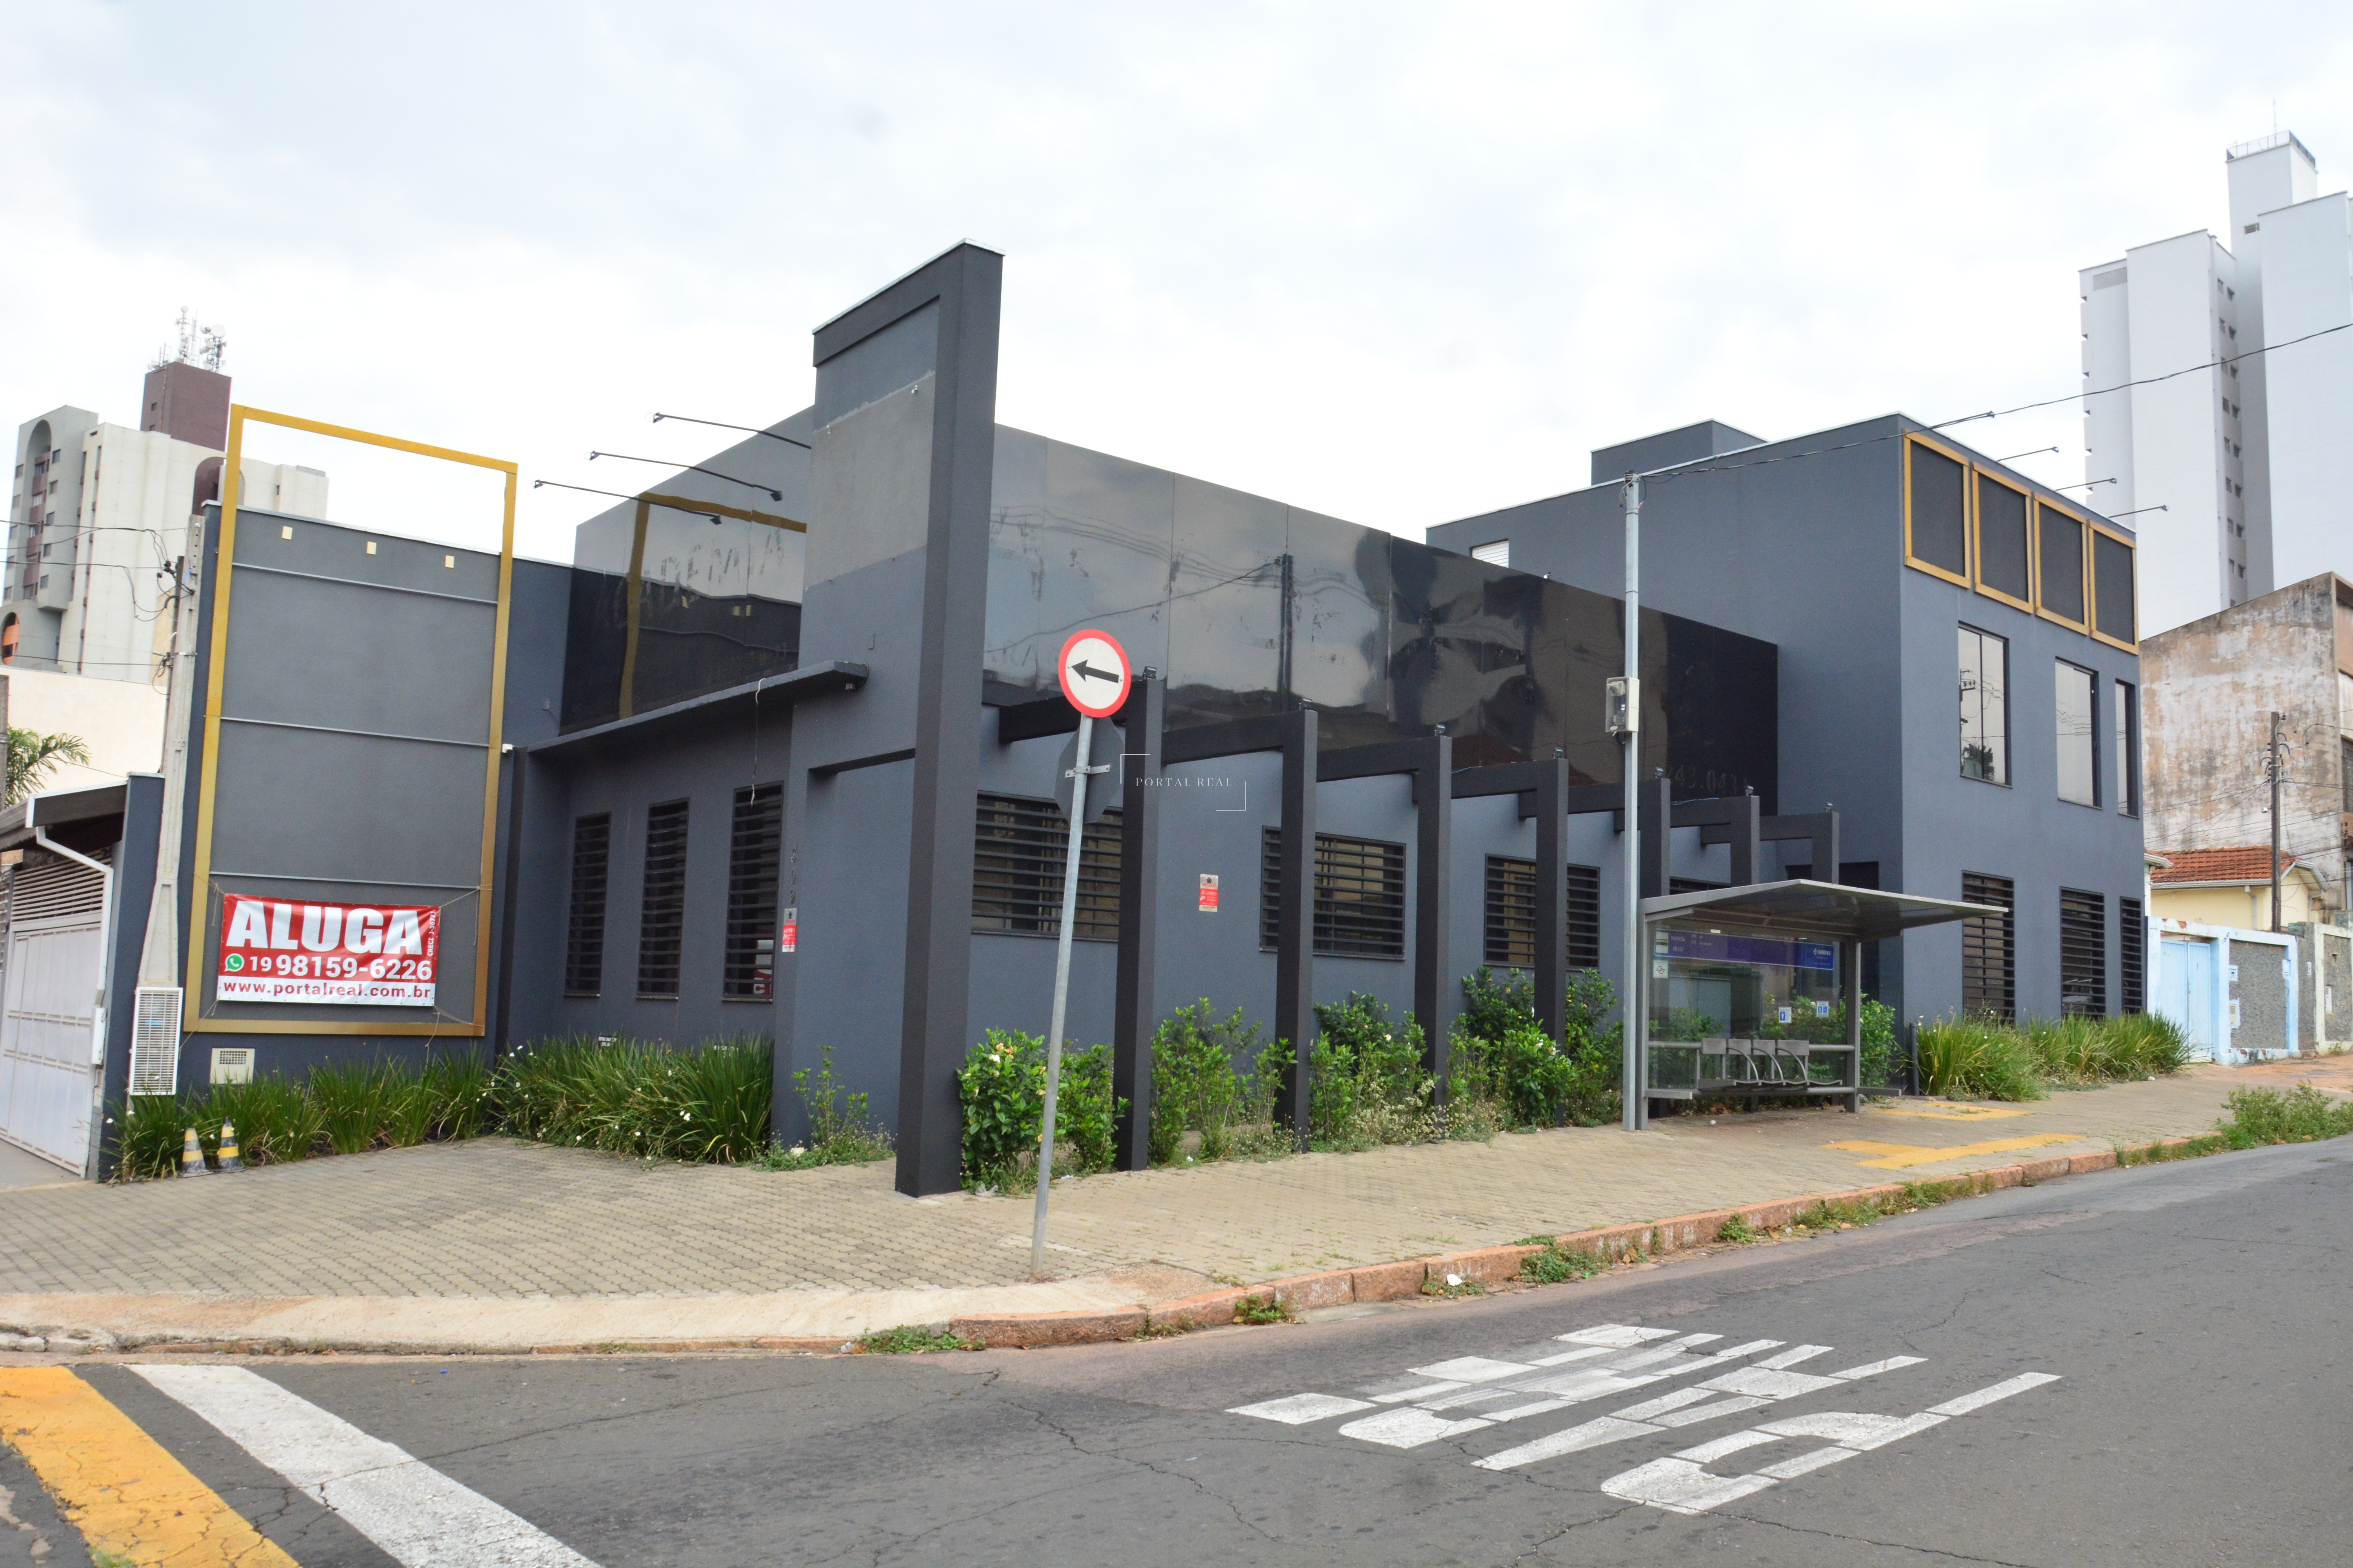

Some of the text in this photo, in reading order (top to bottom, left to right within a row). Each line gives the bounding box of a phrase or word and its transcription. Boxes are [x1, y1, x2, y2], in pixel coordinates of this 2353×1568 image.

[226, 900, 422, 955] ALUGA
[250, 955, 432, 981] 19 98159-6226
[224, 980, 431, 999] www.portalreal.com.br
[1225, 1323, 2063, 1515] PARE
